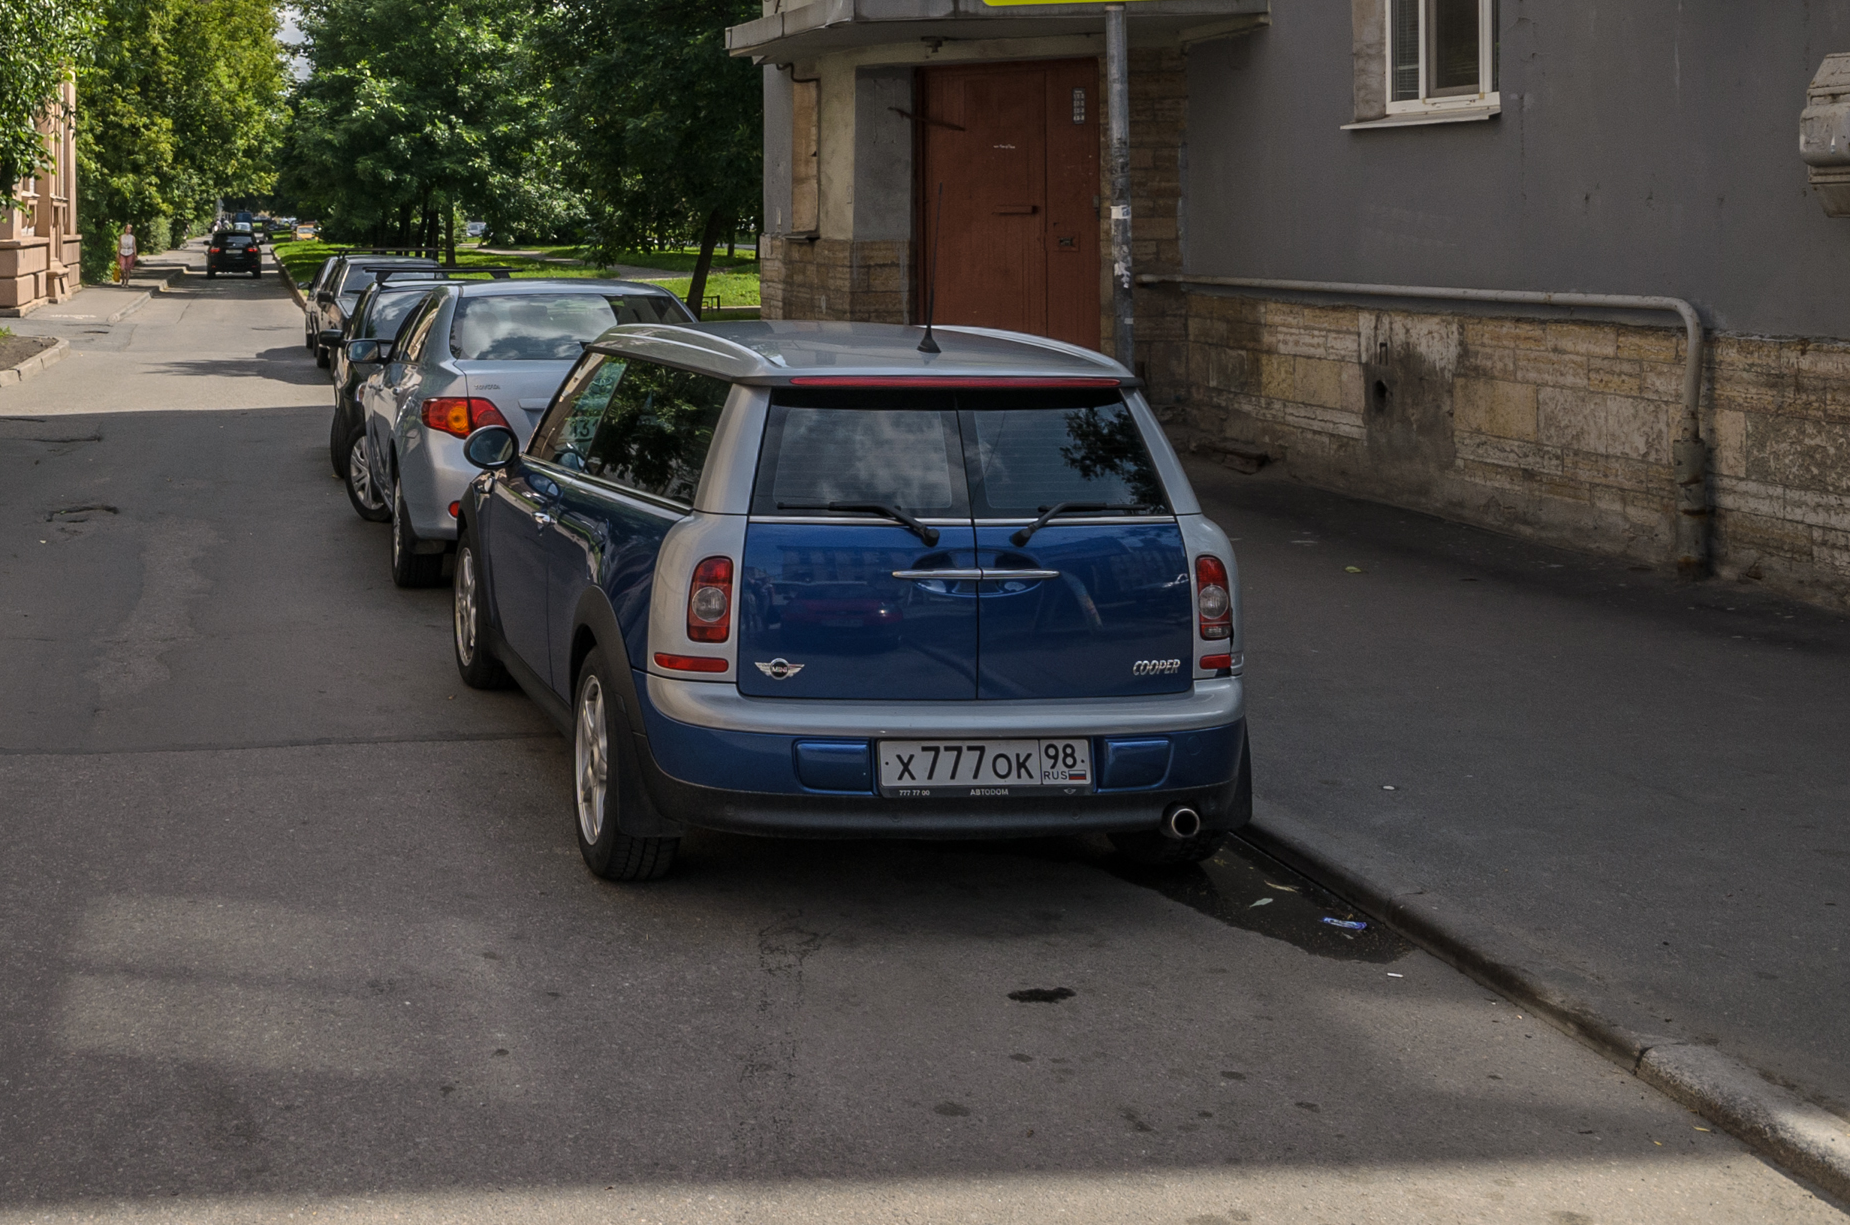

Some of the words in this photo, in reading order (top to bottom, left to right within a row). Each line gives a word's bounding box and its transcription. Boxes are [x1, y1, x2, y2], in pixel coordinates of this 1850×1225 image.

[1132, 658, 1181, 676] COOPER
[1044, 743, 1077, 769] 98
[1043, 770, 1068, 780] RUS
